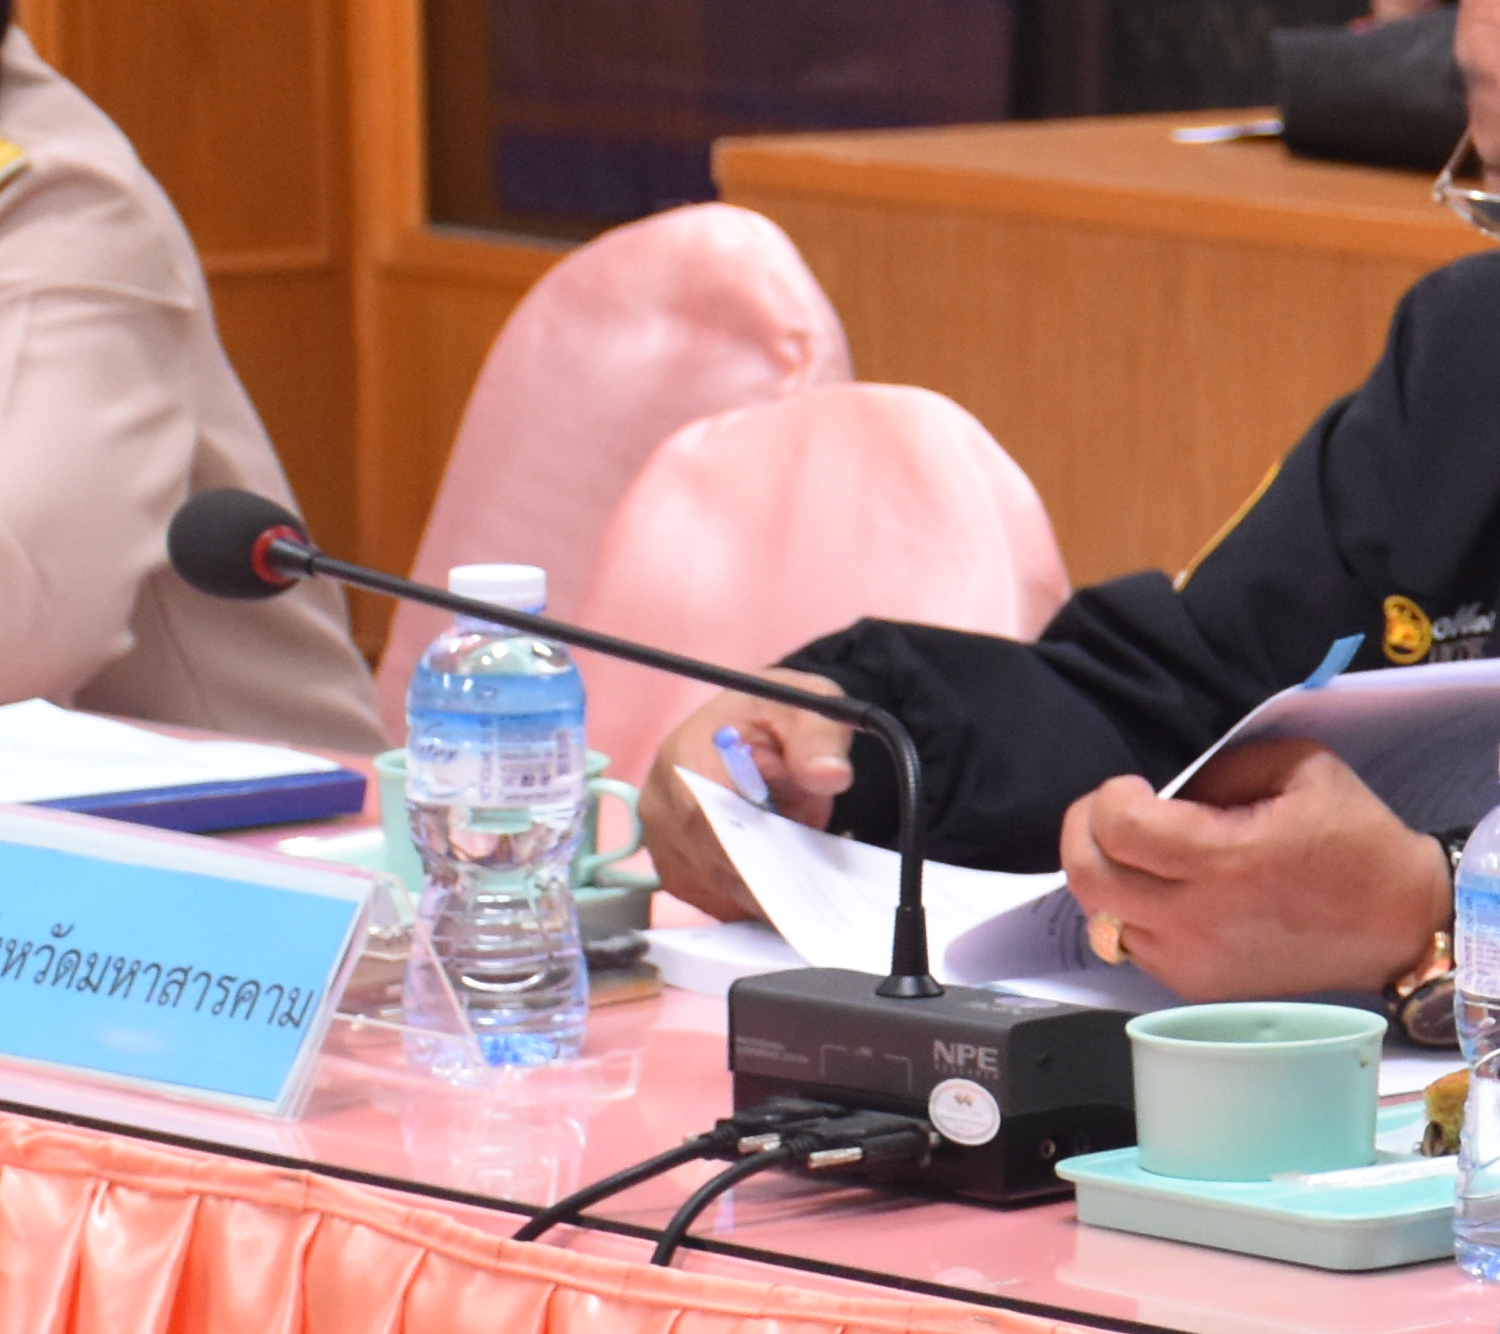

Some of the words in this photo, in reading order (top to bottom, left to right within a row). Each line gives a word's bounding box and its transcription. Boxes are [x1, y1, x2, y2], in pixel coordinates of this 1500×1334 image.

[0, 923, 314, 1028] หวัดมหาสารคาม
[932, 1038, 999, 1072] NPE
